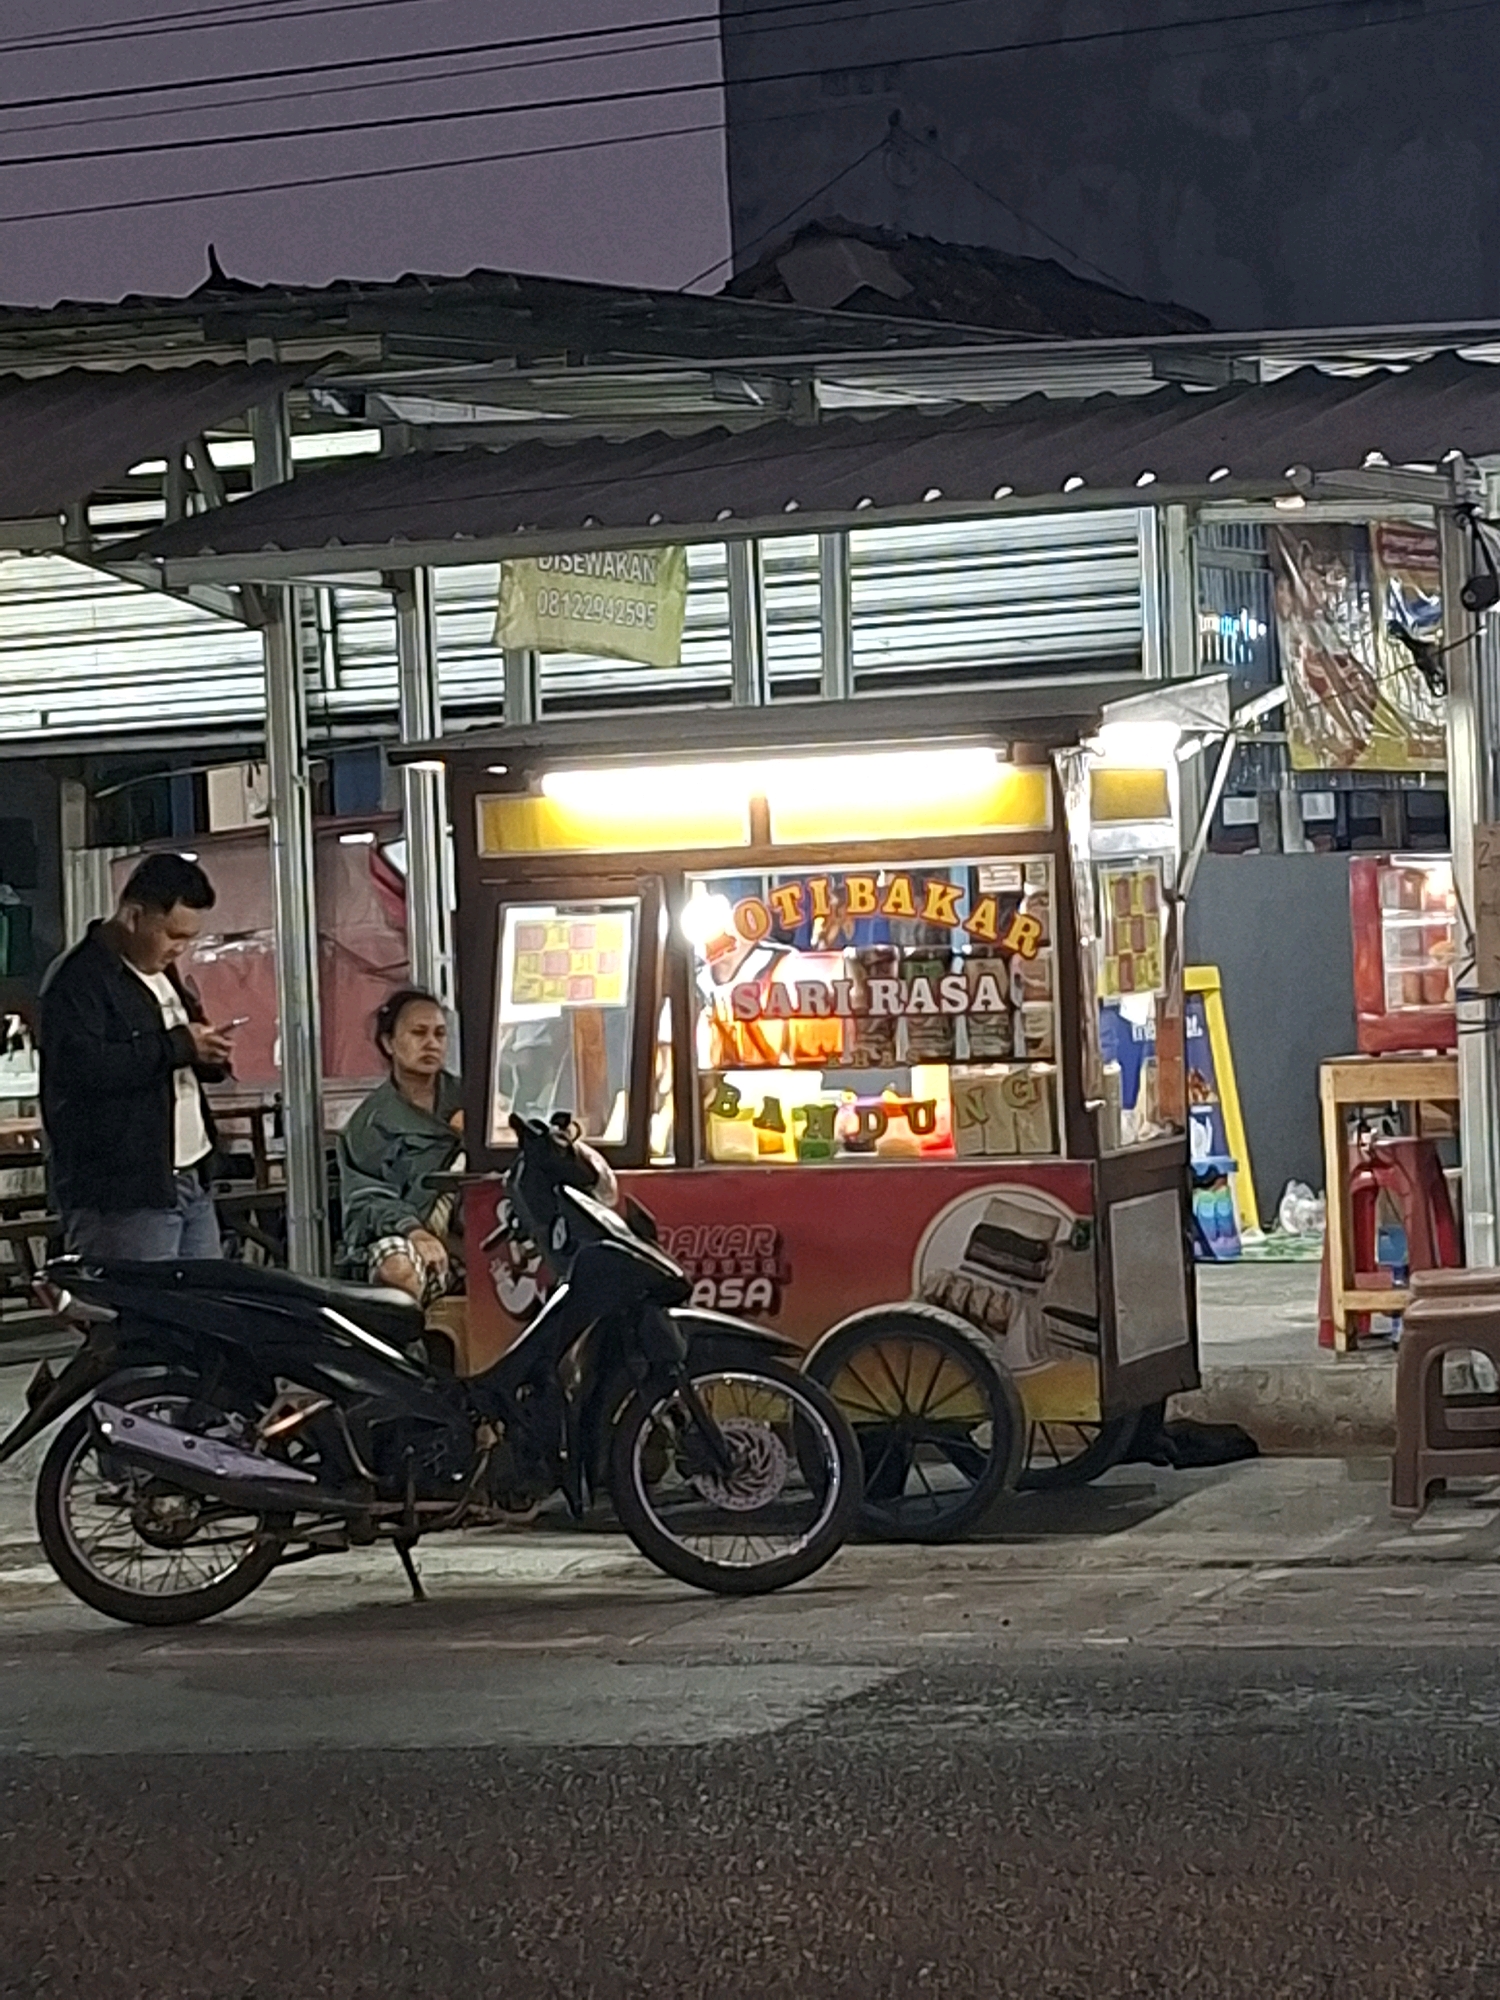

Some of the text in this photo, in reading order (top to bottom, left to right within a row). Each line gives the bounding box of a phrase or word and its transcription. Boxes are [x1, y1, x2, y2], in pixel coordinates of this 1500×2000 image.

[537, 550, 658, 586] DISEWAKAN
[705, 874, 1043, 961] OTI BAKAR
[731, 973, 1007, 1021] SARI RASA
[708, 1068, 1041, 1138] BANDUNG
[688, 1278, 774, 1309] ASA
